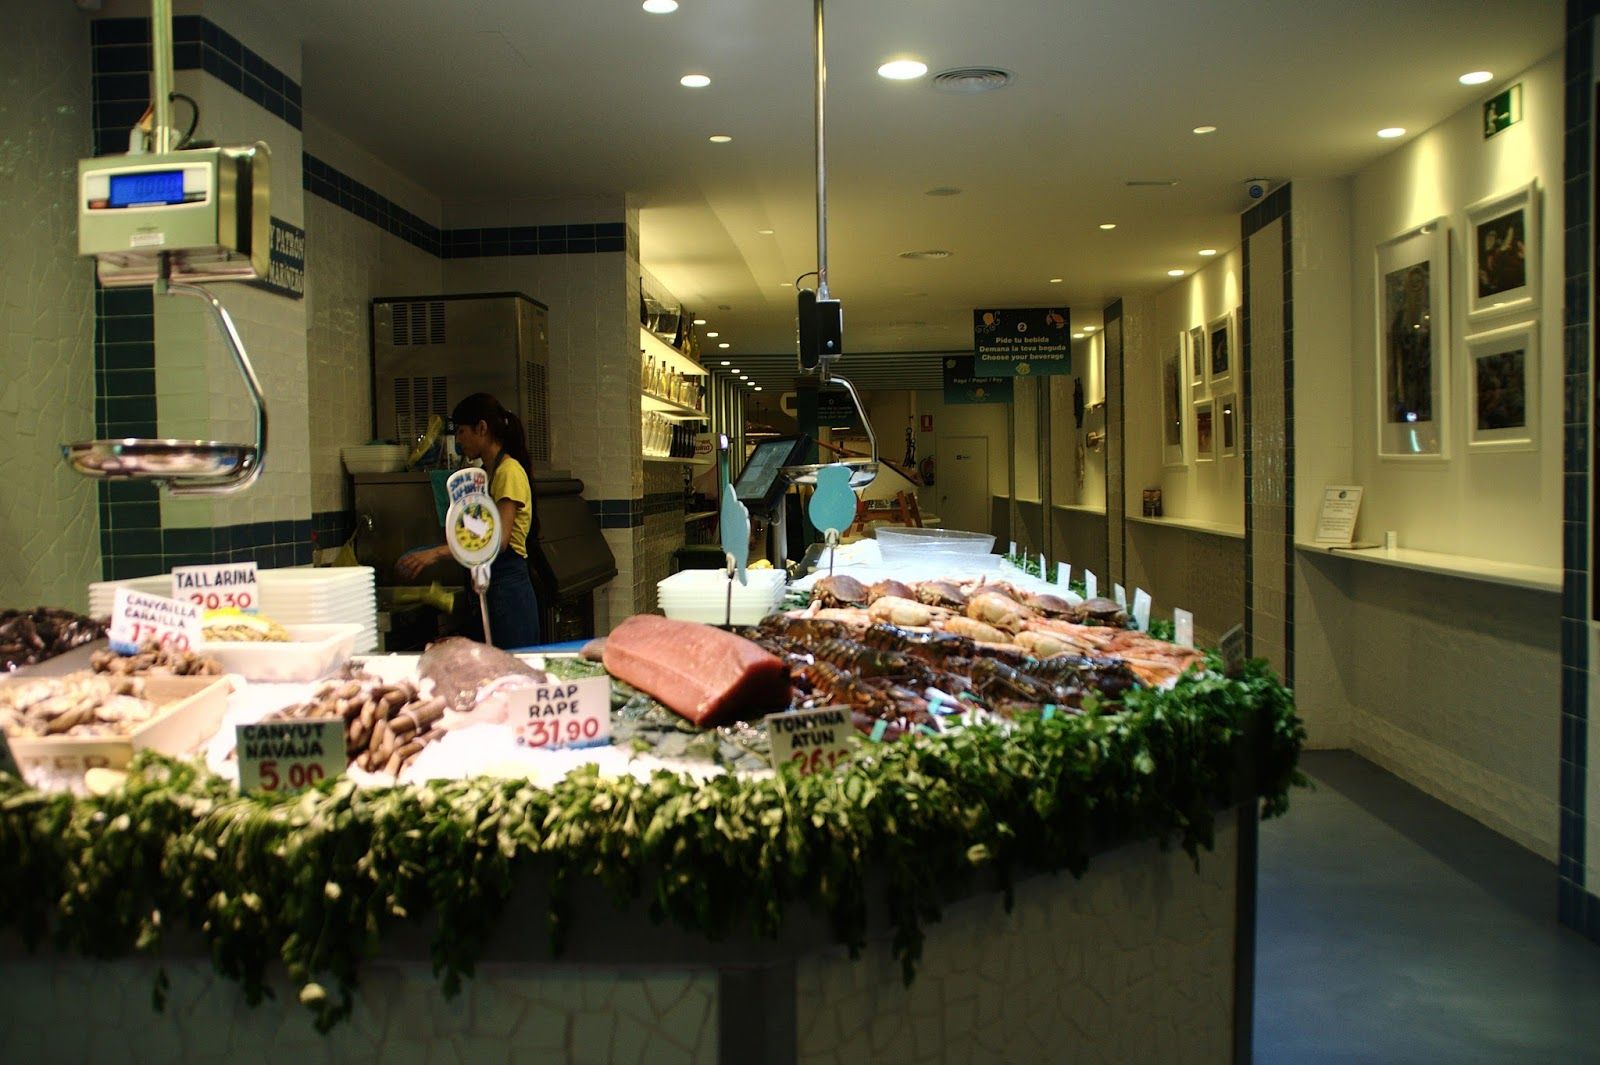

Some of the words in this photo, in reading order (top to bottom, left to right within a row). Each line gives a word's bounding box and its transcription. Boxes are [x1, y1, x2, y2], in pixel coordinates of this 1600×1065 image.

[979, 345, 1010, 353] Demana
[1038, 344, 1066, 353] beguda
[995, 336, 1012, 344] Pide
[1024, 336, 1049, 344] bebida
[1011, 354, 1028, 362] your
[1029, 352, 1065, 361] beverage
[176, 569, 257, 589] TALLARINA
[536, 684, 579, 702] RAP
[528, 700, 580, 718] RAPE
[243, 722, 325, 740] CANYUT
[245, 741, 325, 759] NAVAJA
